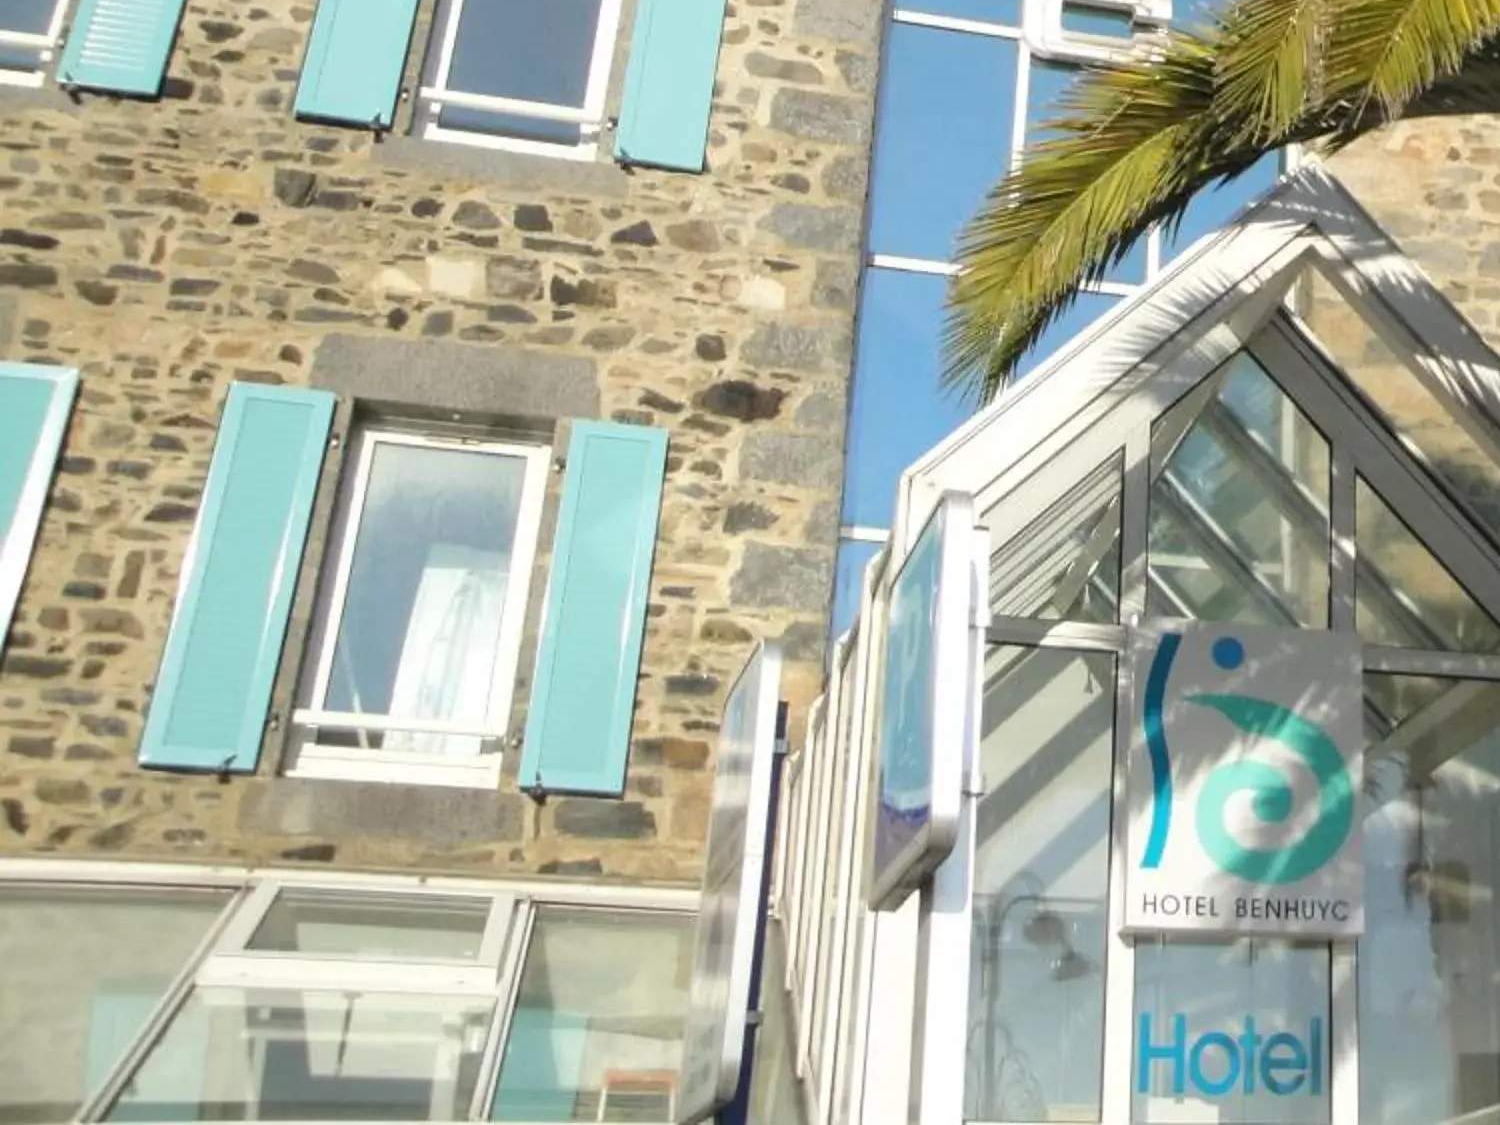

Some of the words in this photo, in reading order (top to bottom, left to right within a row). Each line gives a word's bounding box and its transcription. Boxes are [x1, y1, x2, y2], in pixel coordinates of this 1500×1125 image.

[1142, 893, 1219, 918] HOTEL
[1235, 896, 1350, 922] BENHUYC
[1137, 1012, 1322, 1096] Hotel
